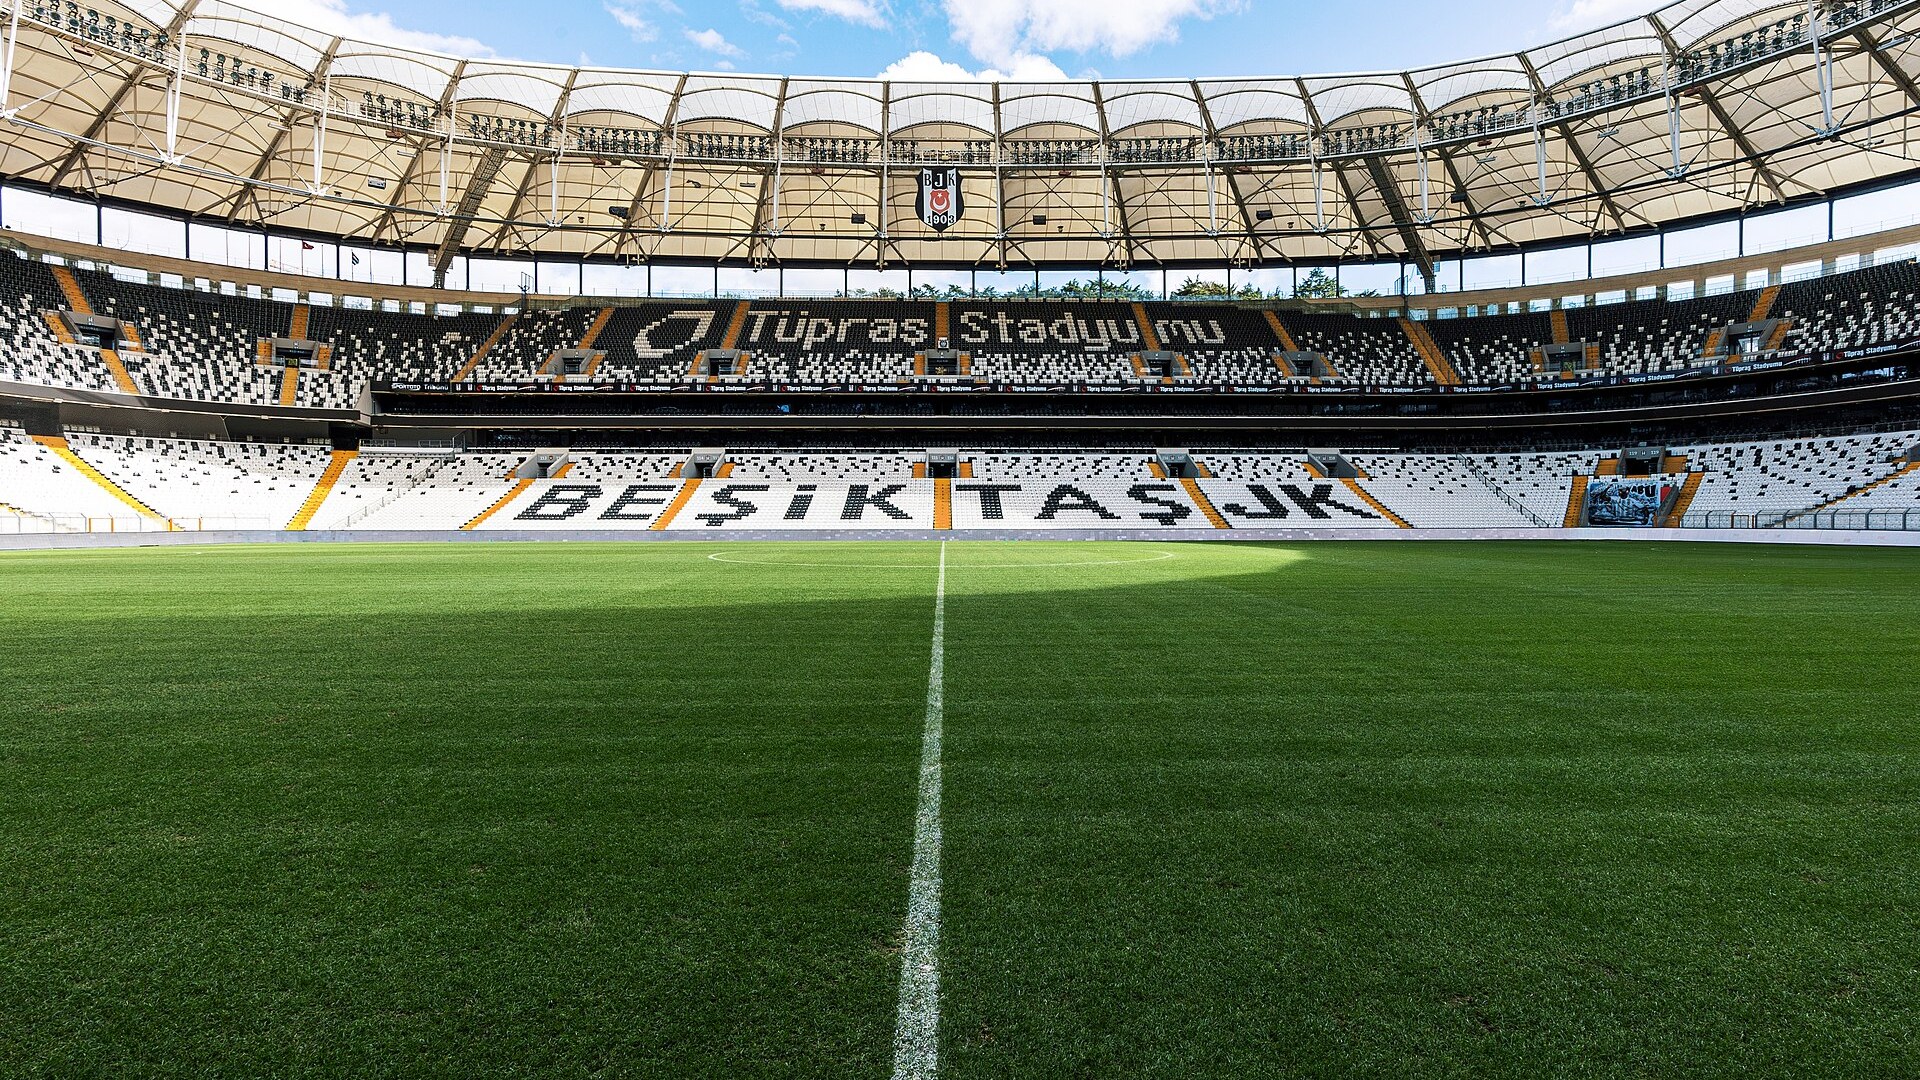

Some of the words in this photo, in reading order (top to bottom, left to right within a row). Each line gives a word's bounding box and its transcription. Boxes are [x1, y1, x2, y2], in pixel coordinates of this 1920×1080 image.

[924, 173, 956, 187] BJK
[926, 215, 955, 224] 1903
[748, 311, 928, 350] Tüpraş
[1844, 350, 1863, 358] Tüpraş
[1866, 344, 1896, 354] Stadyumu
[1732, 366, 1751, 374] Tüpraş
[1753, 361, 1782, 370] Stadyumu
[1222, 484, 1382, 520] JK
